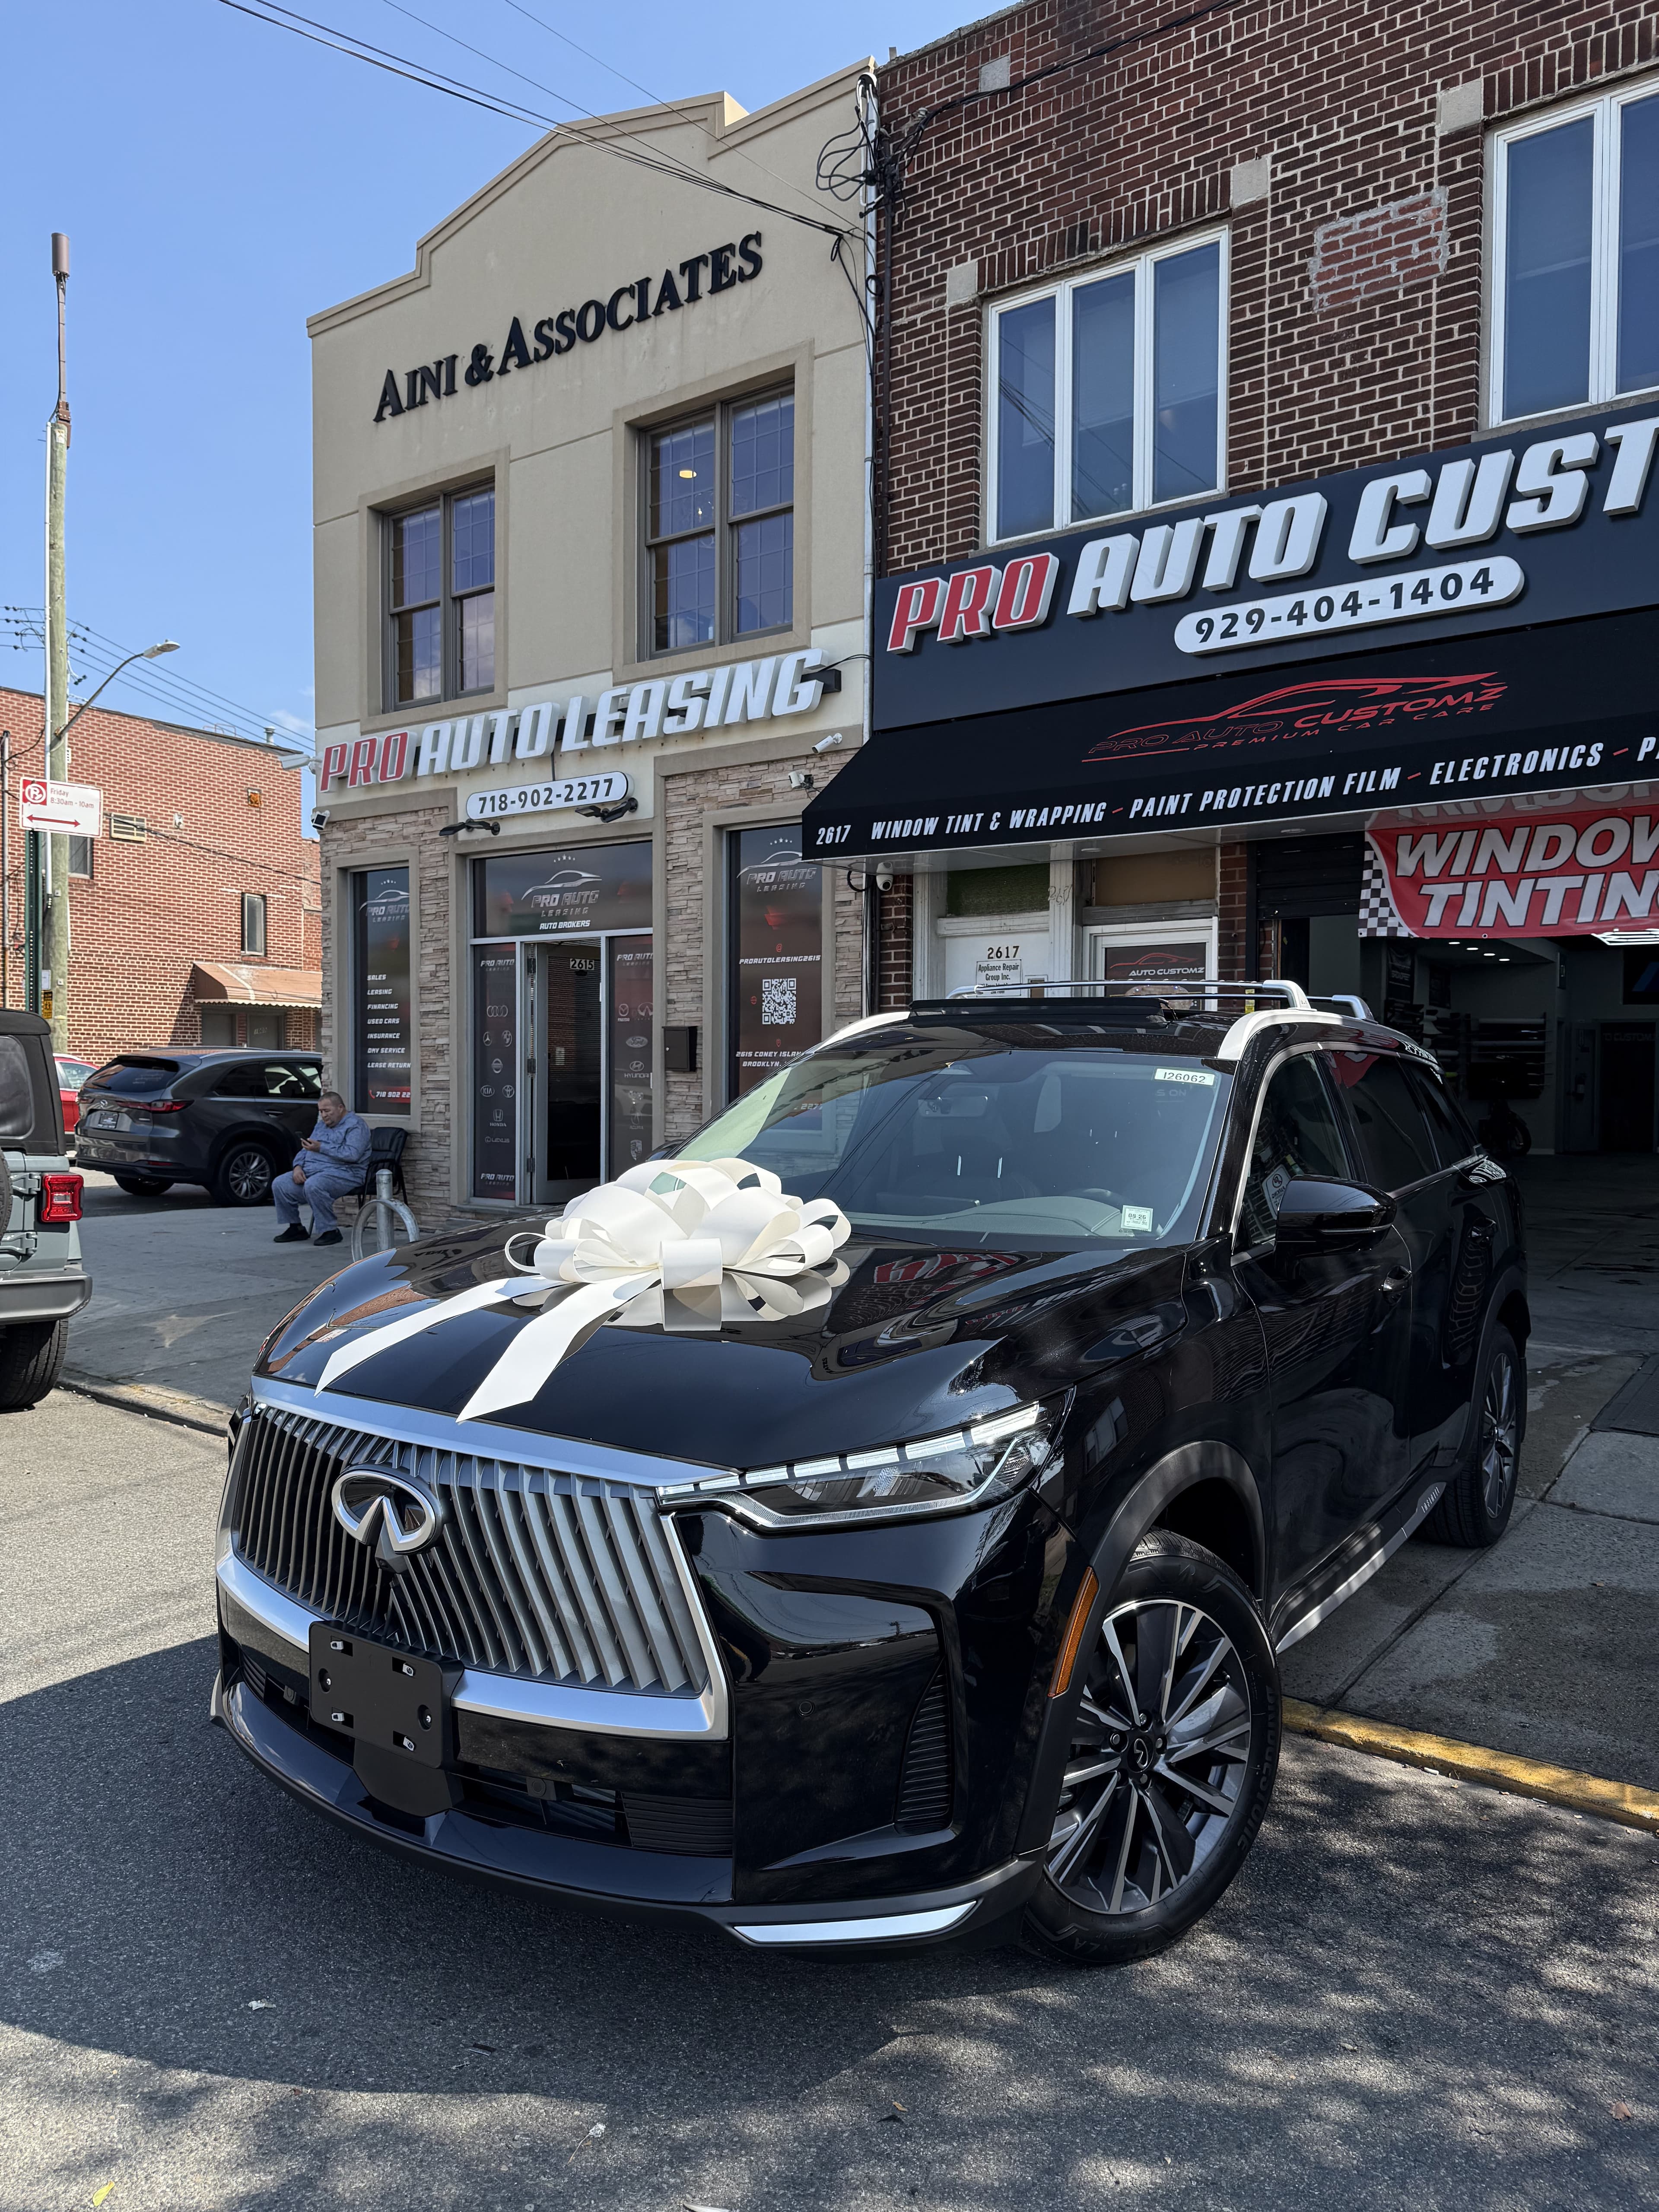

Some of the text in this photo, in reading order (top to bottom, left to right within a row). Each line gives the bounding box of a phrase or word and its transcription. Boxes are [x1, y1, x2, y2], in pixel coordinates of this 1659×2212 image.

[373, 231, 763, 423] AINI & ASSOCIATES
[886, 417, 1659, 654] PRO AUTO CUST
[1195, 567, 1494, 643] 929-404-1404
[320, 648, 829, 793] PRO AUTO LEASING
[1194, 703, 1494, 750] PREMIUM CAR CARE
[1089, 734, 1169, 753] PRO
[1172, 721, 1283, 744] AUTO
[51, 788, 69, 797] Friday
[871, 816, 939, 840] WINDOW
[945, 812, 984, 834] TINT
[989, 812, 1001, 831] &
[1009, 802, 1107, 829] WRAPPING
[1129, 793, 1192, 819] PAINT
[1199, 775, 1335, 811] PROTECTION
[1342, 767, 1401, 795] FILM
[1429, 743, 1604, 785] ELECTRONICS
[1637, 736, 1659, 761] P
[51, 798, 73, 806] 8:30am
[478, 778, 613, 814] 718-902-2277
[816, 824, 851, 845] 2617
[747, 868, 817, 885] PRO AUTO
[757, 883, 805, 892] LEASING
[531, 890, 600, 908] PRO AUTO
[1418, 868, 1659, 928] TINTIN
[365, 906, 385, 916] PRO
[541, 907, 588, 917] LEASING
[558, 920, 591, 928] BROKERS
[739, 955, 821, 964] PROAUTOLEASING2615
[987, 946, 1020, 959] 2617
[571, 959, 594, 969] 2615
[978, 963, 1019, 973] Appliance Repair
[985, 973, 1000, 982] Group
[1163, 1072, 1206, 1083] 126062
